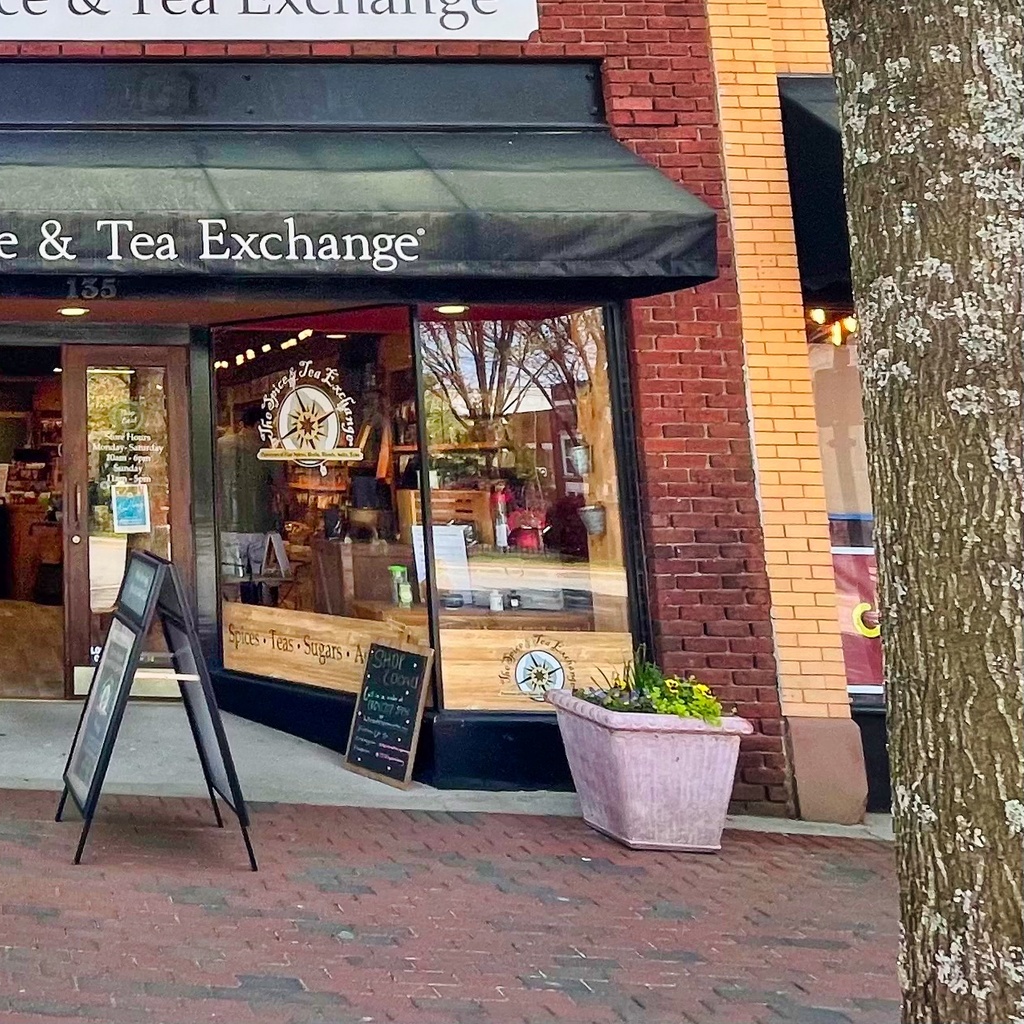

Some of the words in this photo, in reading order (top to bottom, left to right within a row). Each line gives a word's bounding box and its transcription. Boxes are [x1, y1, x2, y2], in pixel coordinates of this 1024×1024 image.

[38, 219, 77, 260] &
[96, 219, 179, 260] Tea
[66, 277, 117, 299] 135
[126, 432, 151, 442] Hours
[128, 443, 164, 454] Saturday
[113, 465, 143, 476] Sunday
[228, 623, 260, 649] Spices
[269, 629, 294, 653] Teas
[303, 634, 343, 665] Sugars
